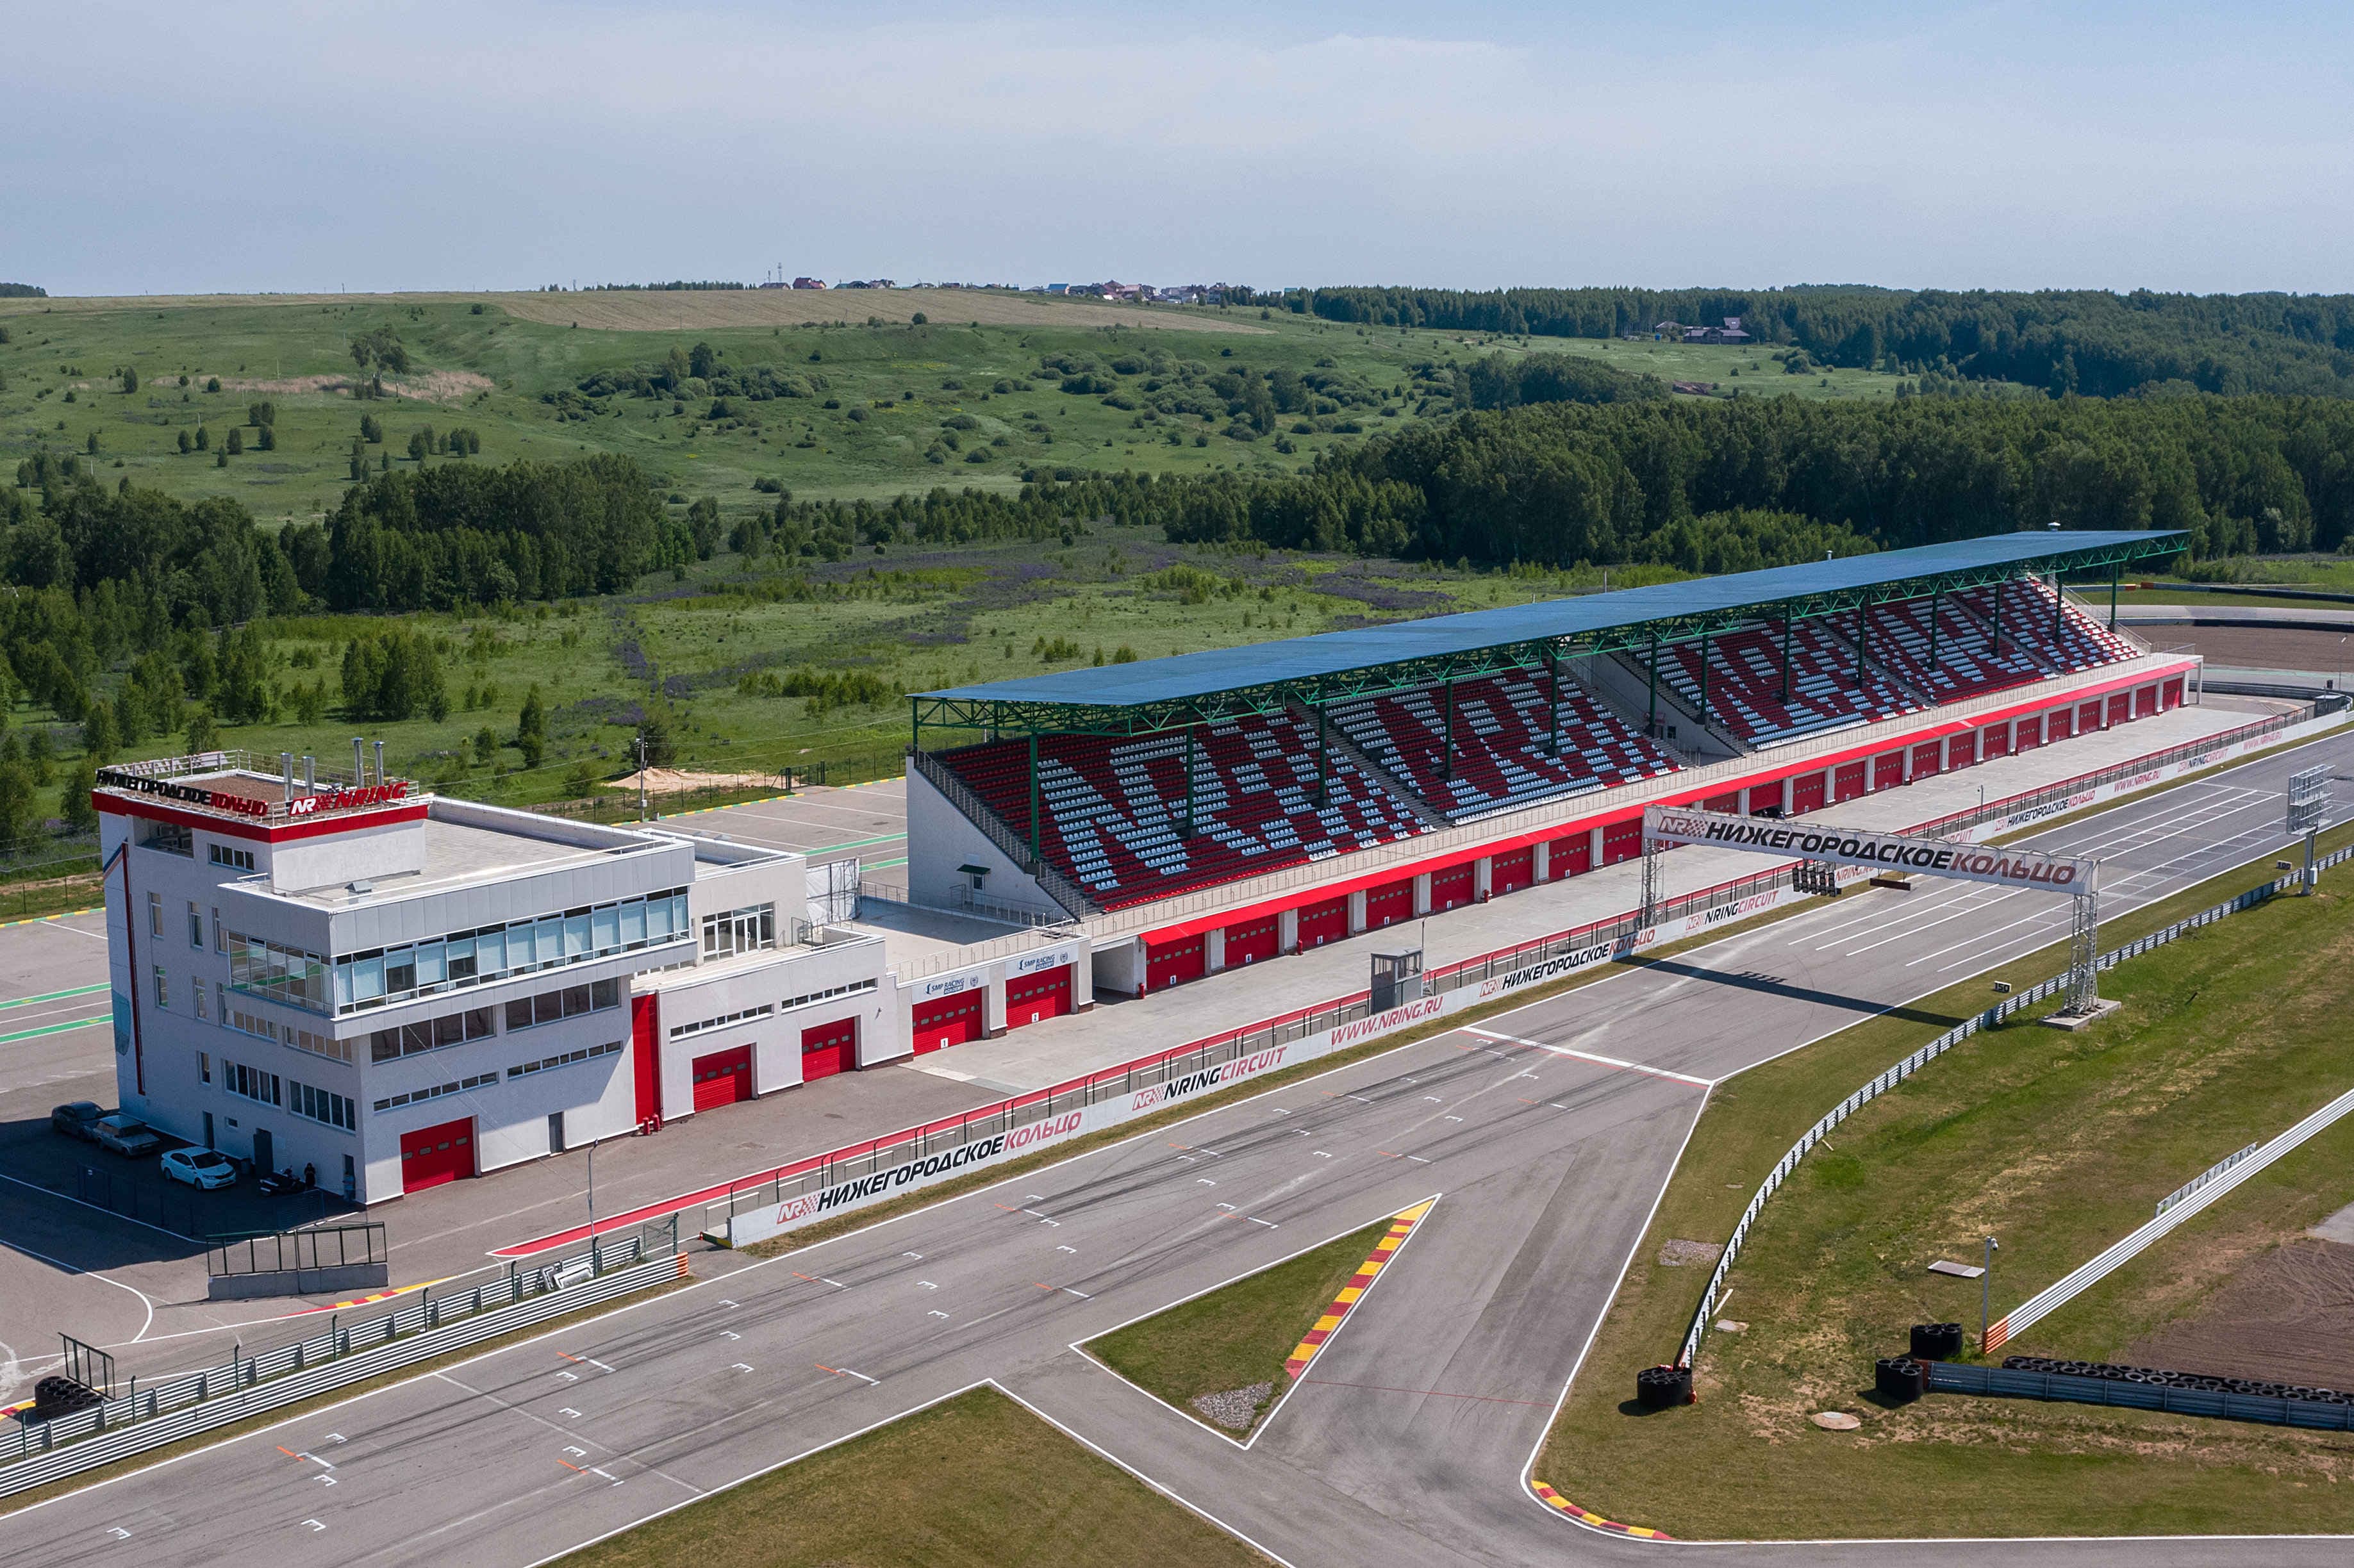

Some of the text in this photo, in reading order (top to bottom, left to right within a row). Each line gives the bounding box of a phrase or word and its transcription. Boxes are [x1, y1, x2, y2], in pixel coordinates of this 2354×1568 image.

[290, 782, 408, 814] NR NRING
[1659, 817, 1689, 834] NR
[1705, 902, 1739, 925] NRING
[1737, 891, 1779, 914] CIRCUIT
[1036, 954, 1056, 963] RACING
[932, 978, 965, 991] SMP RACING
[1994, 982, 2010, 993] 150
[1331, 996, 1443, 1046] WWW.NRING.RU
[1133, 1046, 1288, 1110] NR NRING CIRCUIT
[778, 1200, 804, 1223] NR
